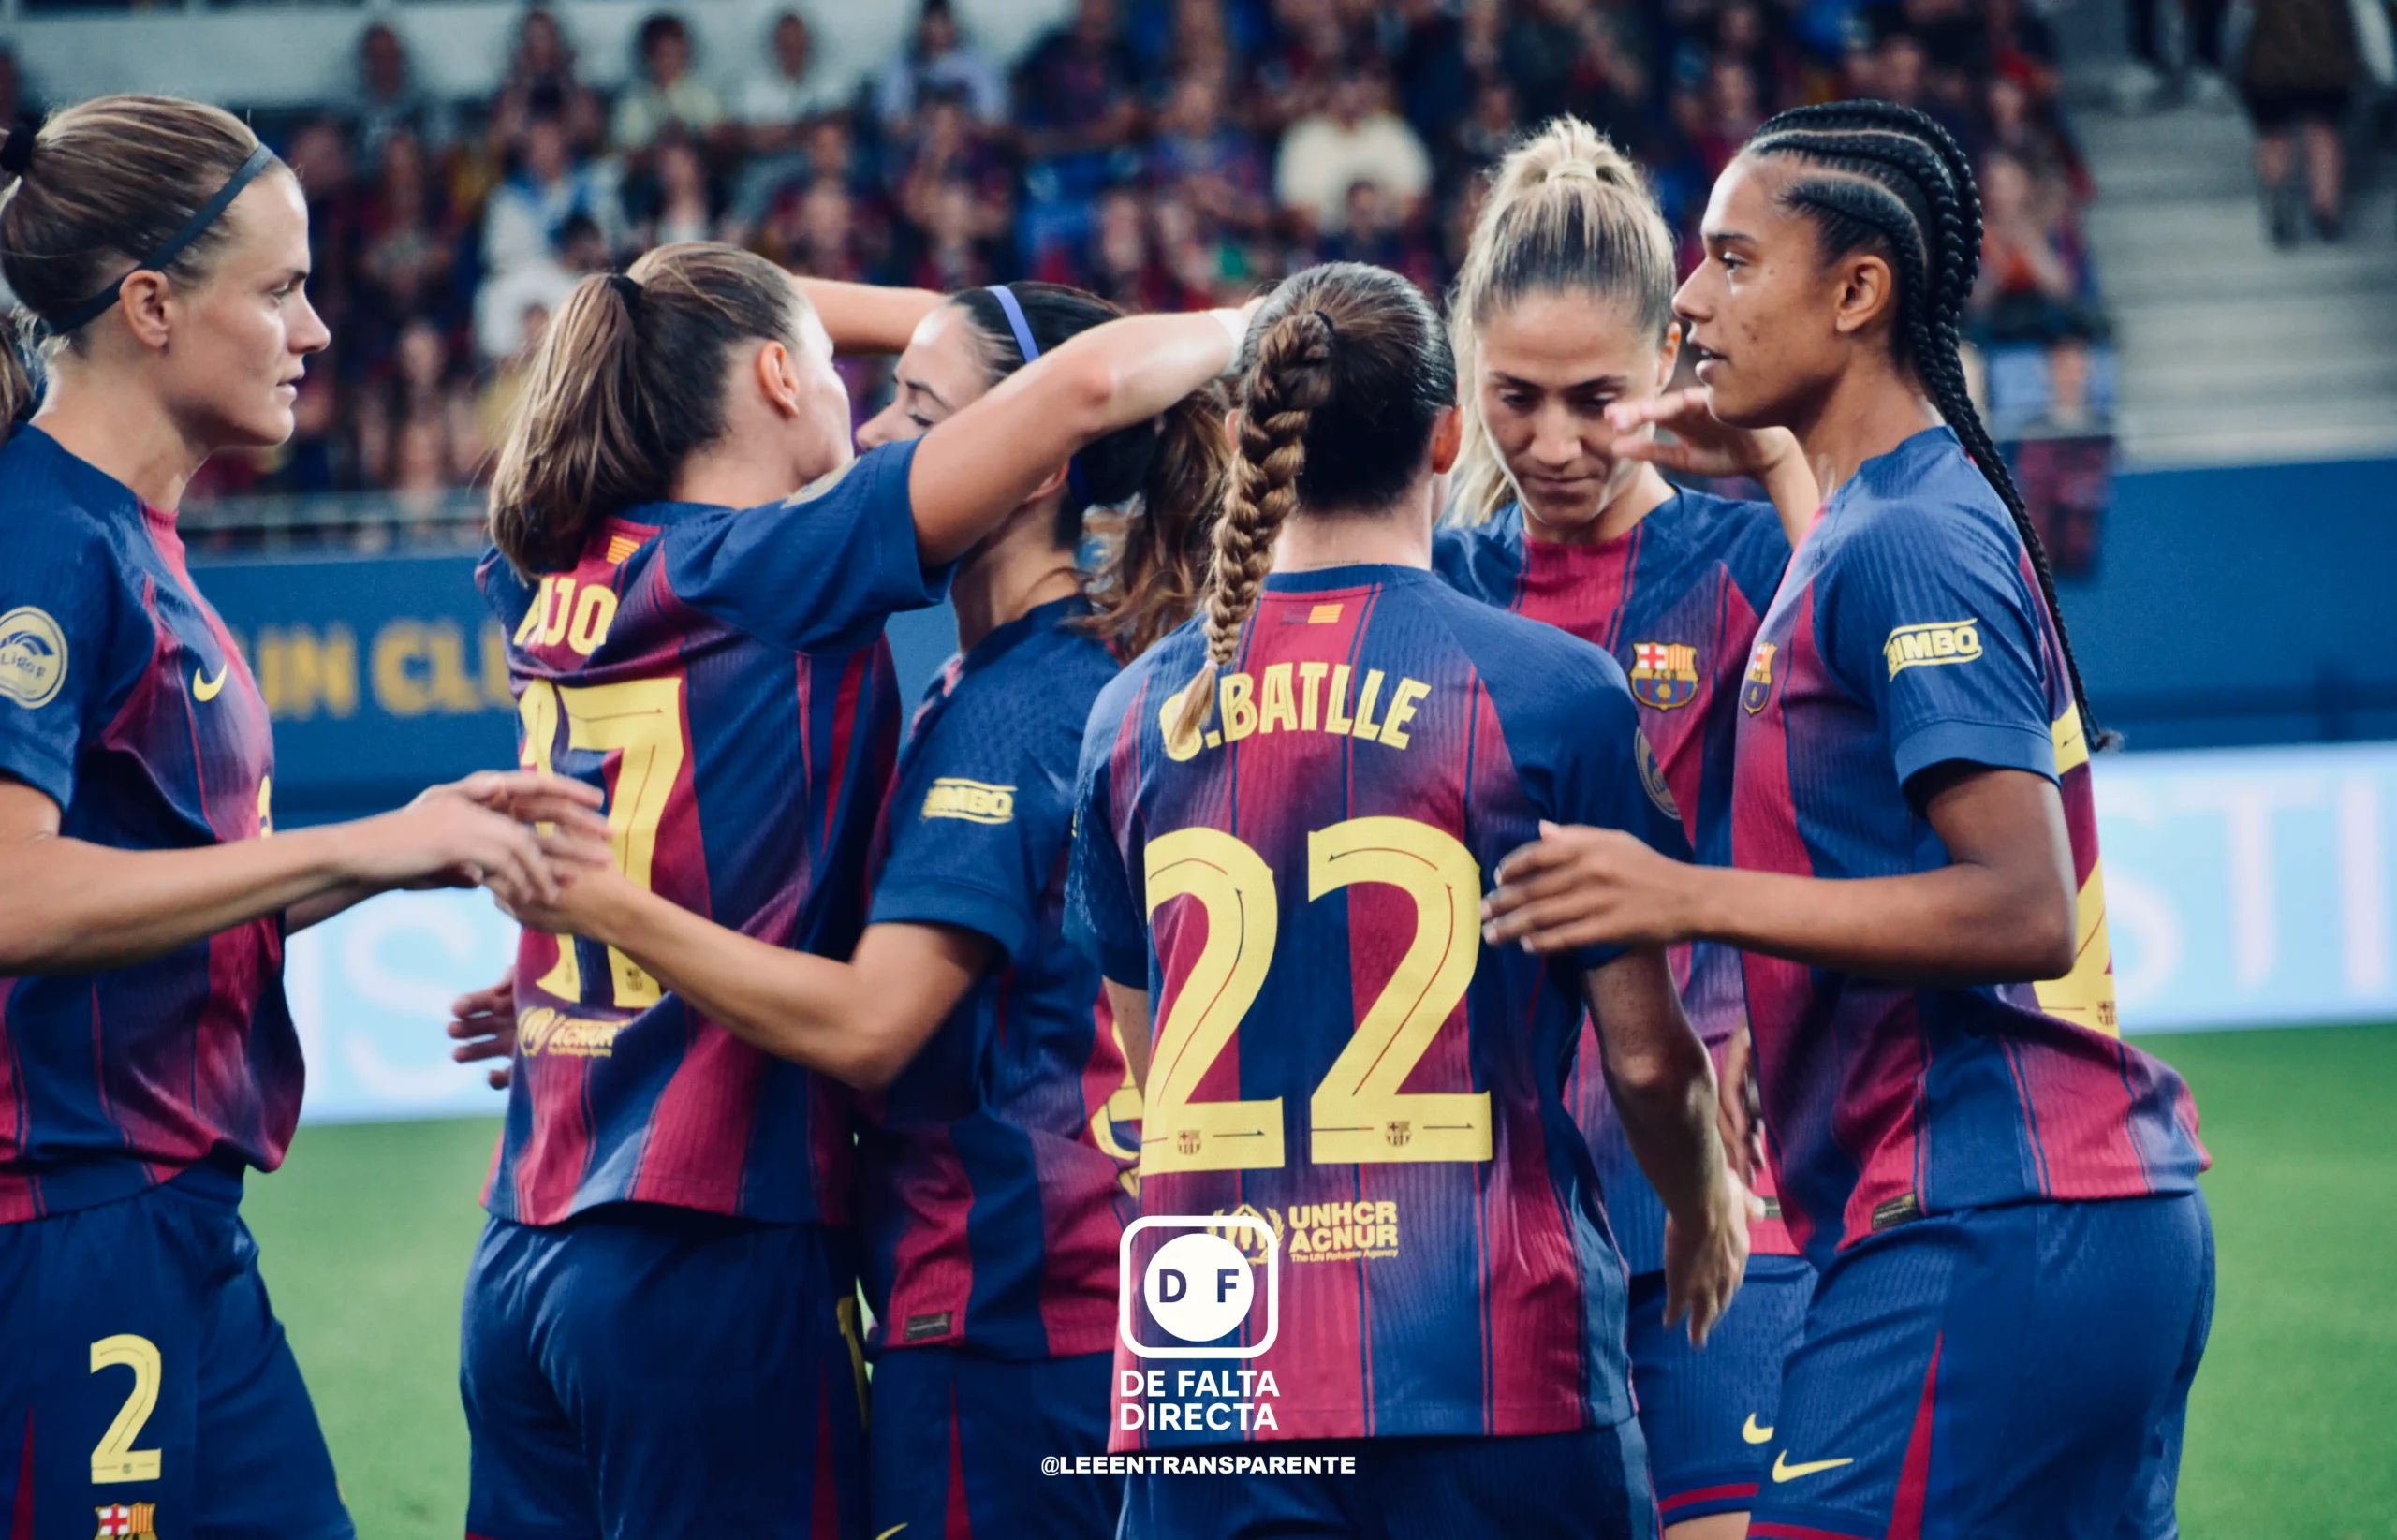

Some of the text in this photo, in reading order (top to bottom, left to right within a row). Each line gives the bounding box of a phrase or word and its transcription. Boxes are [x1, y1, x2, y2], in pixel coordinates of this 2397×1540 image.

[518, 676, 684, 1008] 17
[1140, 815, 1492, 1177] 22
[1288, 1201, 1398, 1230] UNHCR
[1288, 1225, 1399, 1254] ACNUR
[91, 1334, 162, 1484] 2
